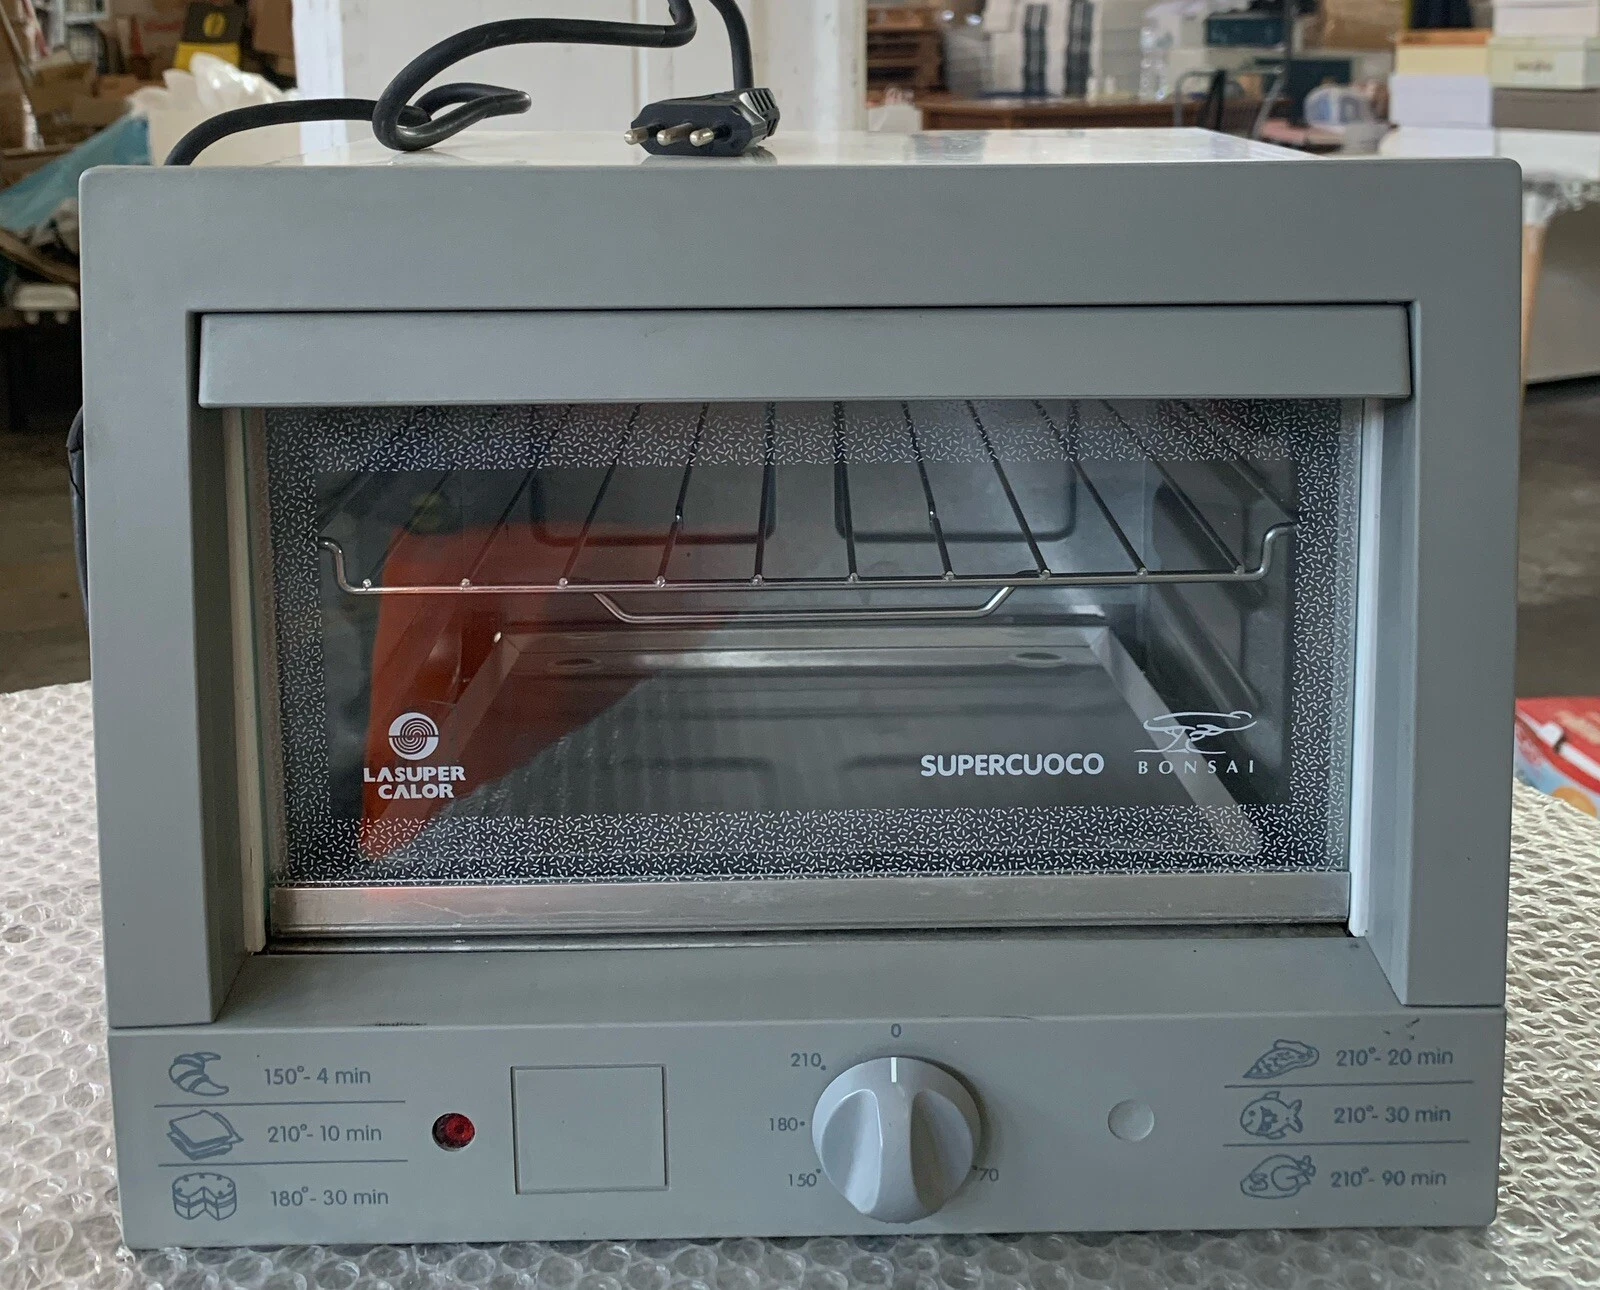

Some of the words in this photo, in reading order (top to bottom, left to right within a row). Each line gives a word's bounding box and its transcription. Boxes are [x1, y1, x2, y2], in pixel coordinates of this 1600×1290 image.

[920, 753, 1105, 777] SUPERCUOCO
[1138, 760, 1255, 776] BONSAI
[378, 783, 455, 800] CALOR
[890, 1023, 902, 1038] 0
[790, 1053, 822, 1068] 210
[1388, 1049, 1412, 1066] 20
[1417, 1048, 1454, 1065] min
[316, 1068, 329, 1085] 4
[335, 1067, 371, 1084] min
[1385, 1107, 1409, 1123] 30
[1415, 1106, 1451, 1122] min
[769, 1117, 799, 1132] 180
[320, 1126, 340, 1142] 10
[346, 1125, 382, 1142] min
[788, 1173, 817, 1188] 150
[979, 1168, 999, 1182] 70
[1382, 1170, 1405, 1186] 90
[1411, 1169, 1447, 1186] min
[323, 1190, 348, 1206] 30
[353, 1188, 389, 1206] min
